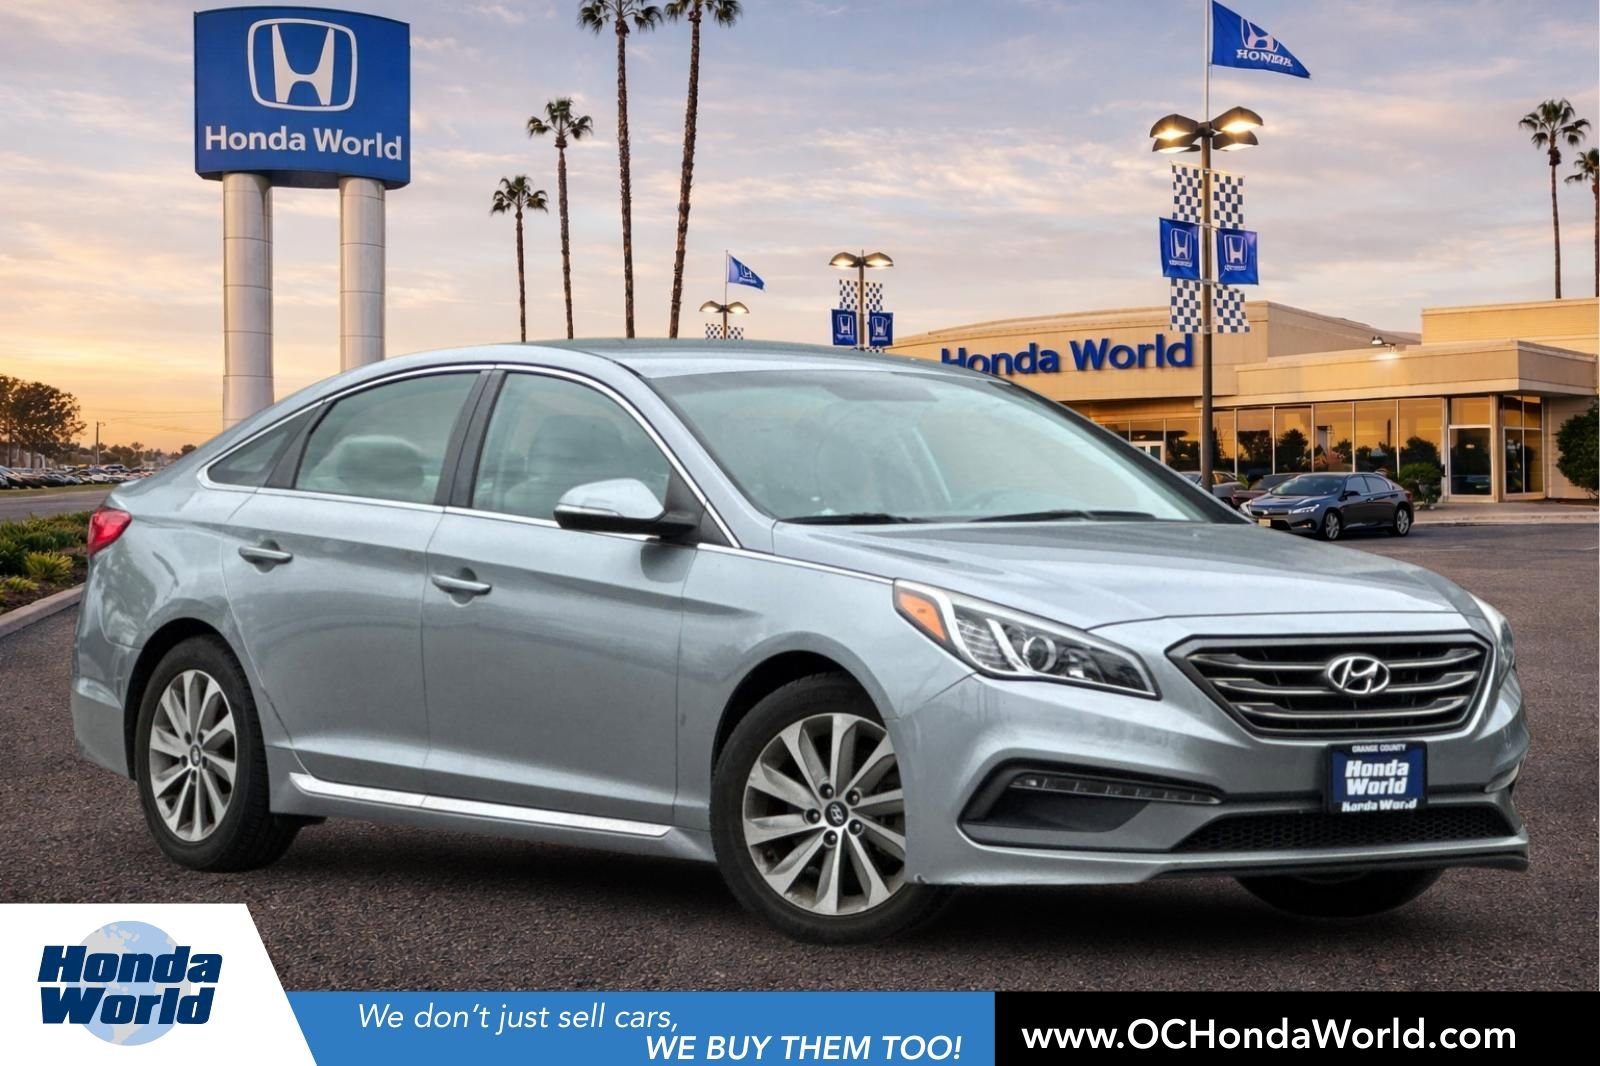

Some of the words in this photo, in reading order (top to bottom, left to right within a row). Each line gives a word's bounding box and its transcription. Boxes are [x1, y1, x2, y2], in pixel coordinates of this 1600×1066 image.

[205, 125, 306, 151] Honda
[313, 127, 402, 160] World
[1069, 333, 1194, 371] World
[1352, 745, 1379, 753] ORANGE
[1379, 743, 1407, 752] COUNTY
[1345, 759, 1410, 778] Honda
[1346, 777, 1407, 796] World
